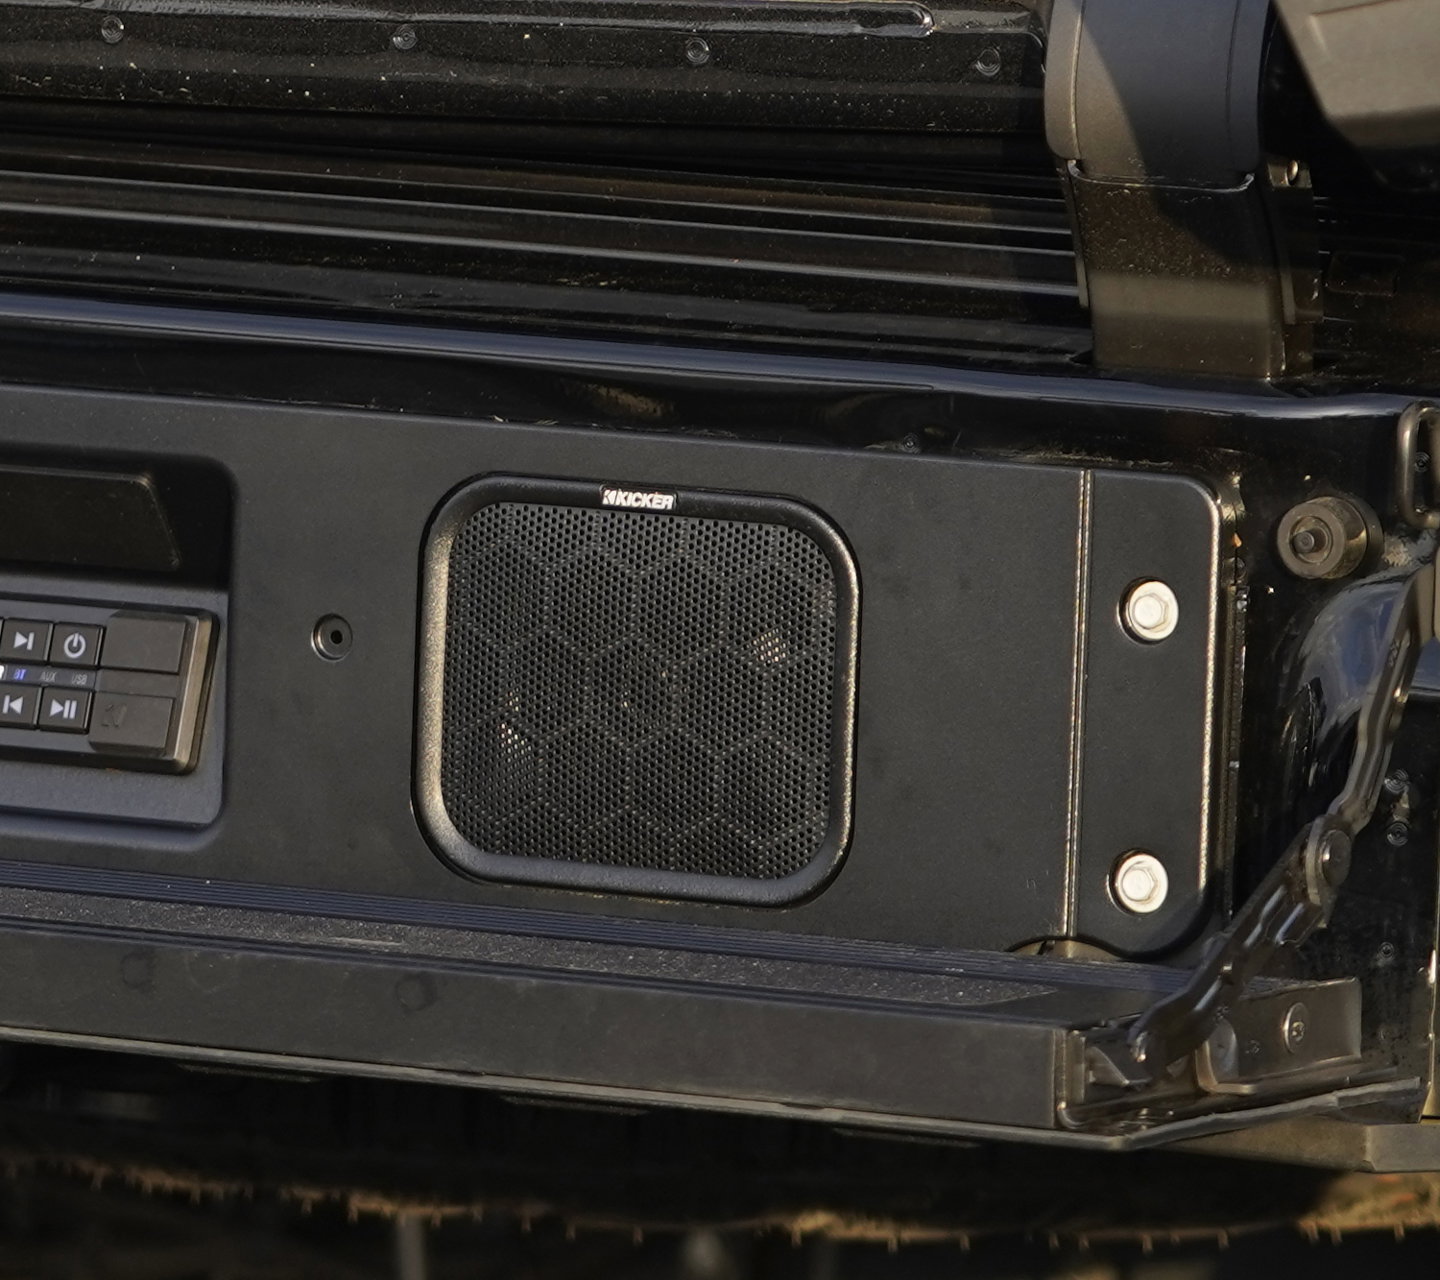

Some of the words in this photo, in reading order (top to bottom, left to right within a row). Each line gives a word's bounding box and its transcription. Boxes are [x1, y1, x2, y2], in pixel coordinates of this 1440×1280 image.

[615, 488, 674, 510] KICKER
[39, 671, 58, 683] AUX
[71, 673, 89, 685] USB
